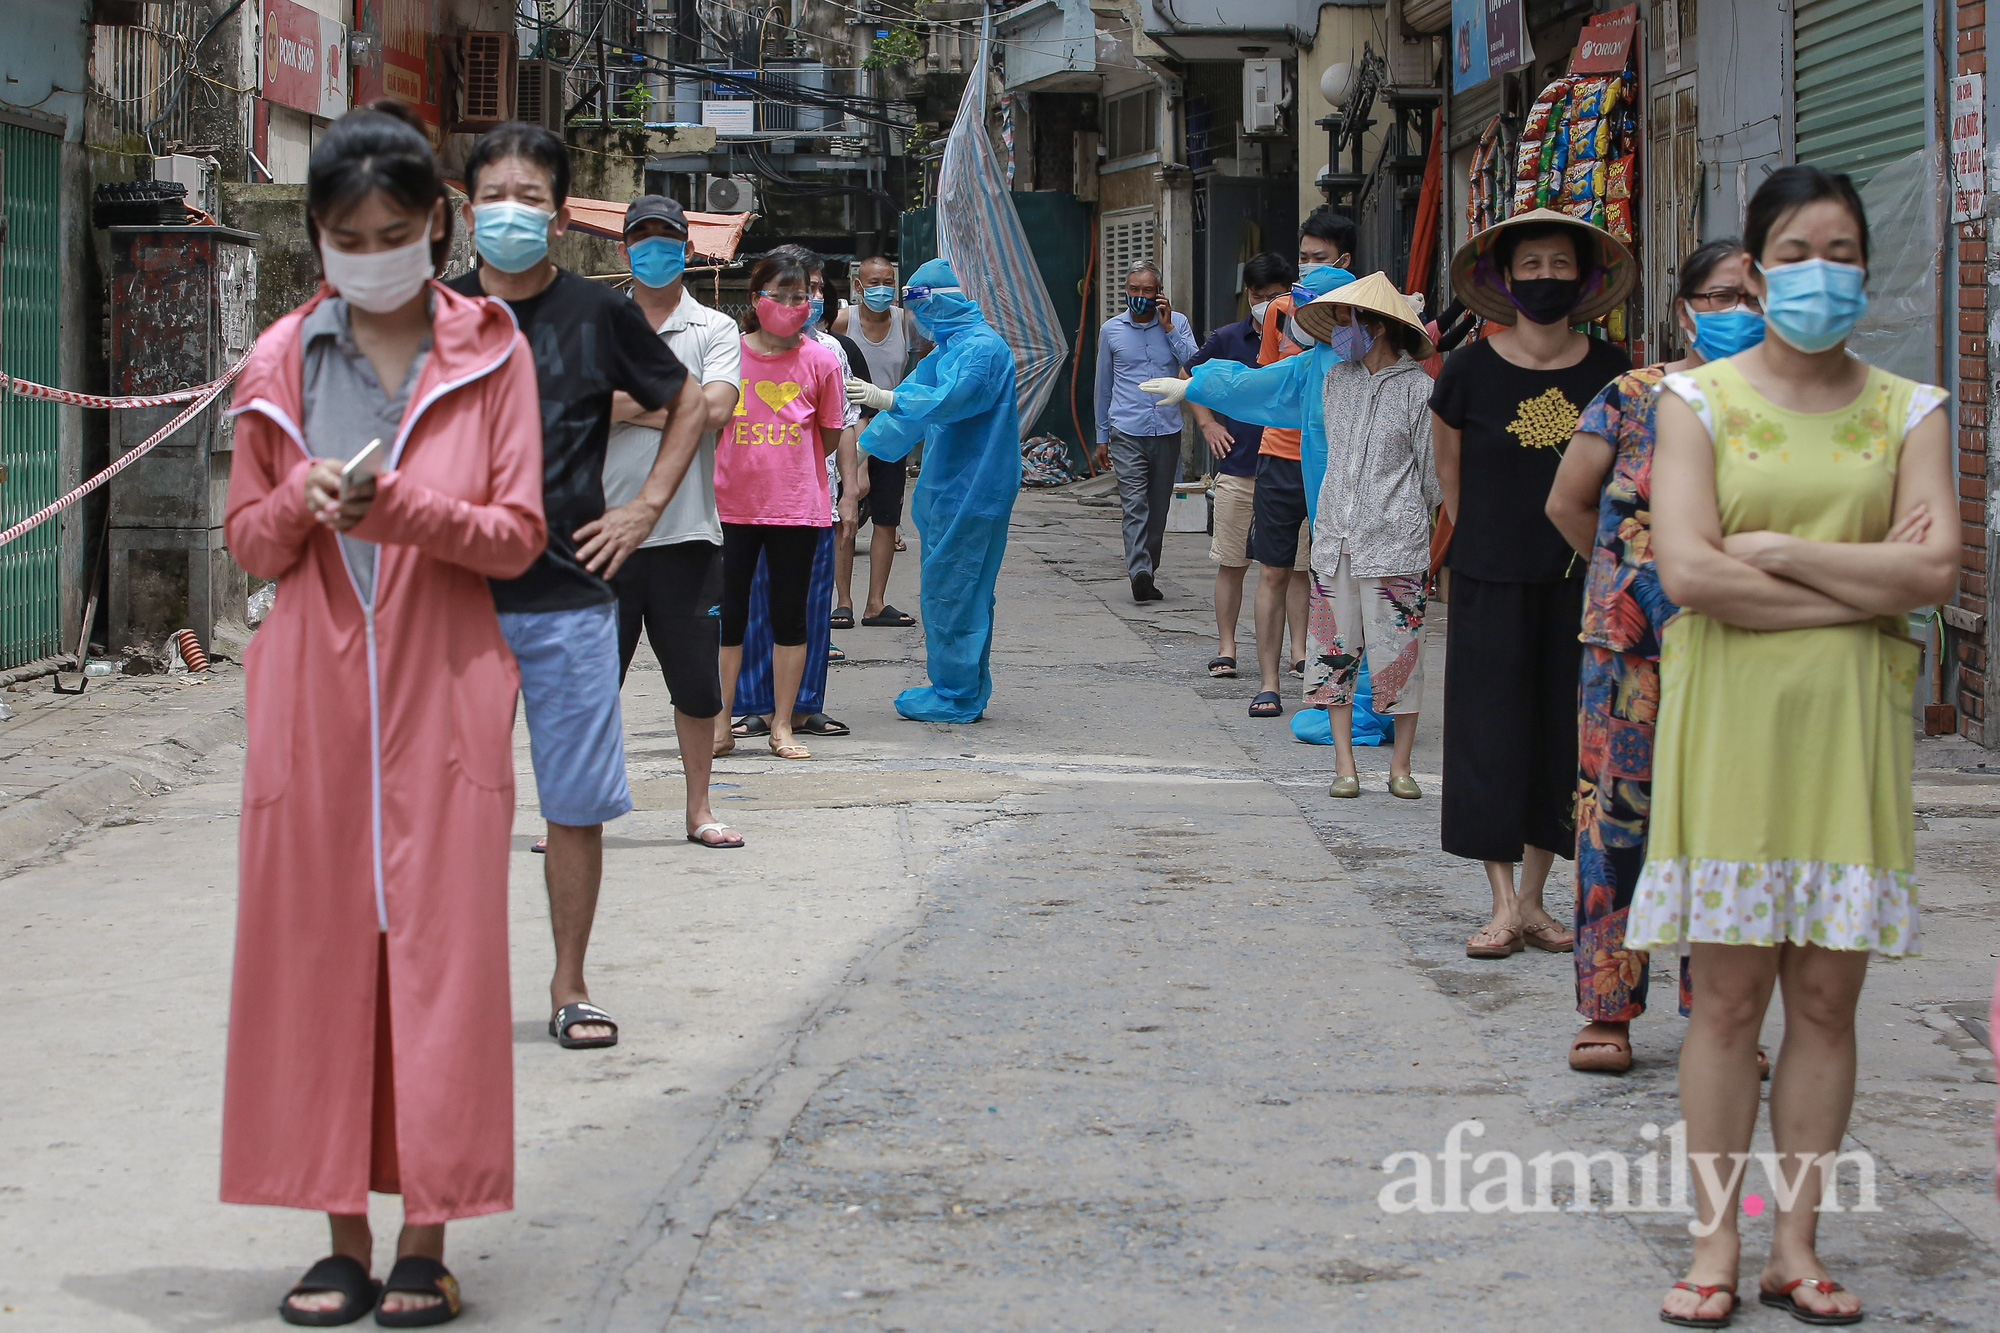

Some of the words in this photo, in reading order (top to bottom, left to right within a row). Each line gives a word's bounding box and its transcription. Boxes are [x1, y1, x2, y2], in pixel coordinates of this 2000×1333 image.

[280, 36, 297, 68] PORK
[298, 43, 315, 73] SHOP
[1594, 41, 1624, 56] ORION
[732, 378, 749, 416] I
[730, 421, 802, 445] ESUS
